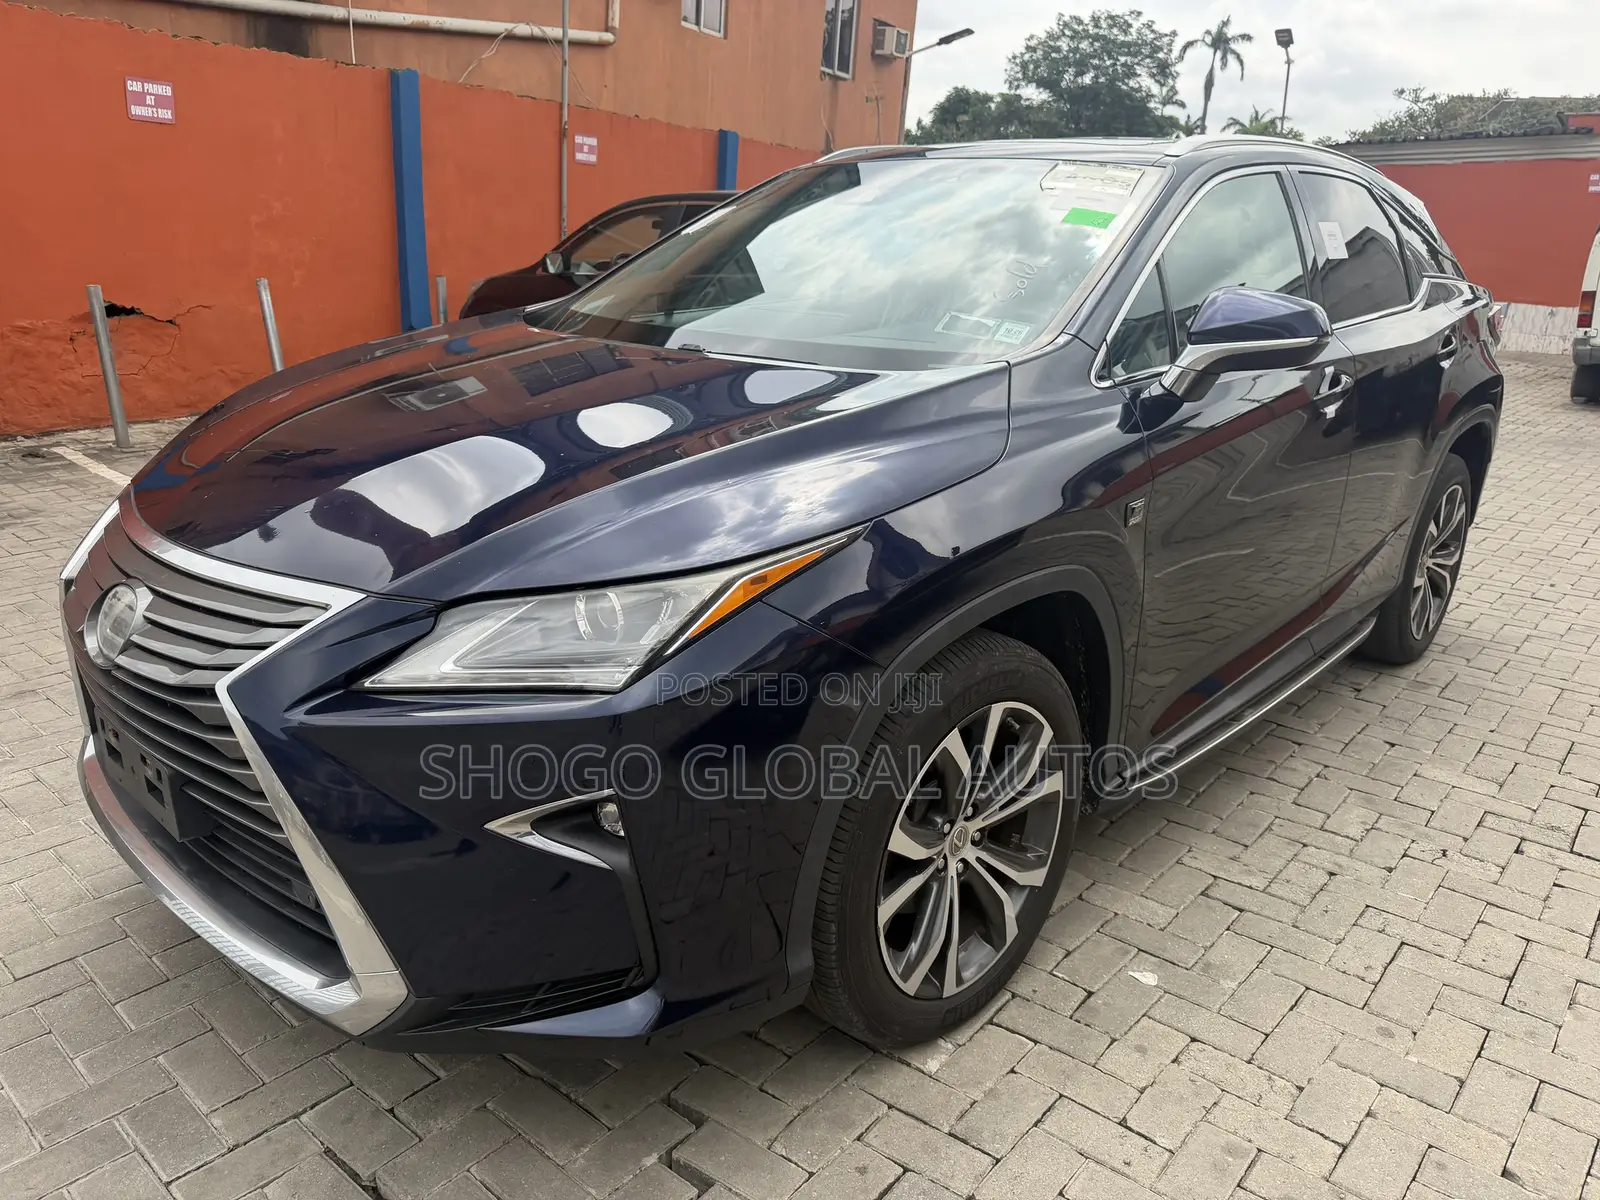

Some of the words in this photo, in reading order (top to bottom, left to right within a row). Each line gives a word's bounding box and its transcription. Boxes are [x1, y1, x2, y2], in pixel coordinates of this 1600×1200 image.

[127, 80, 143, 92] CAR
[144, 82, 171, 96] PARKED
[146, 95, 155, 105] AT
[131, 105, 157, 117] OWNER'S
[158, 108, 172, 119] RISK
